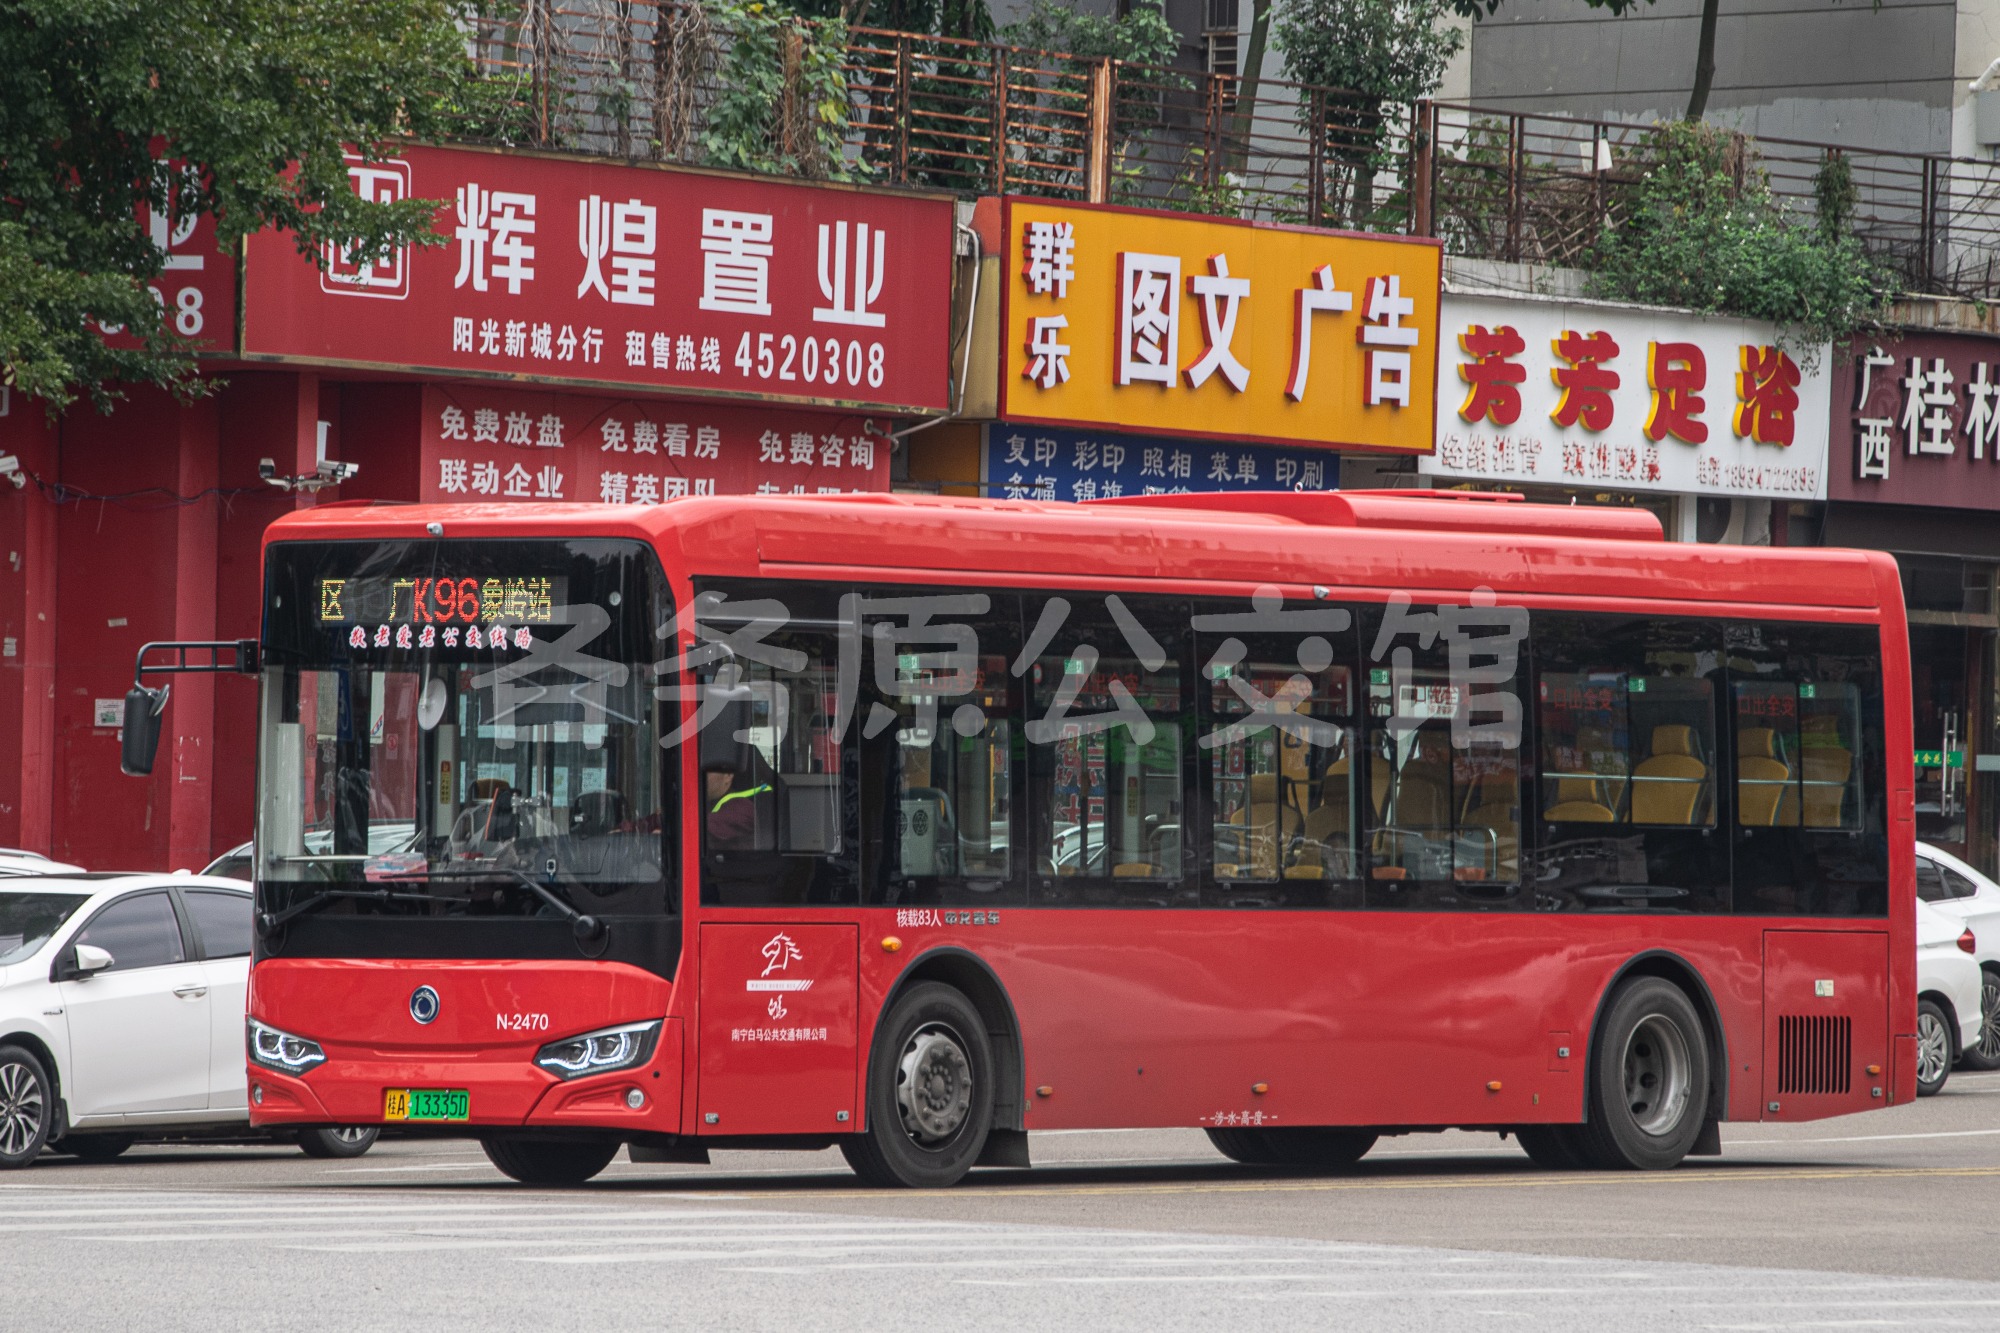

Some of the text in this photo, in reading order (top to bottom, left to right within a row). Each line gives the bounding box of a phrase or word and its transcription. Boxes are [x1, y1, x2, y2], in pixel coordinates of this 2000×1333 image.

[455, 182, 886, 328] 辉煌置业
[1022, 221, 1075, 389] 群乐
[1114, 251, 1419, 408] 图文广告
[453, 316, 886, 389] 阳光新城分行 租售热线 4520308
[1457, 324, 1802, 448] 芳芳足浴
[1857, 345, 1896, 480] 广西
[440, 405, 875, 471] 免费放盘 免费看房 免费咨询
[1004, 433, 1324, 490] 复印 彩印 照相 菜单 印刷
[439, 459, 564, 499] 联动企业
[1003, 471, 1057, 501] 条幅
[413, 577, 479, 623] K96
[349, 623, 533, 650] 敬老爱老公交线路
[896, 908, 941, 927] 核载83人
[496, 1013, 549, 1031] N-2470
[731, 1027, 827, 1042] 南宁白马公共交通有限公司
